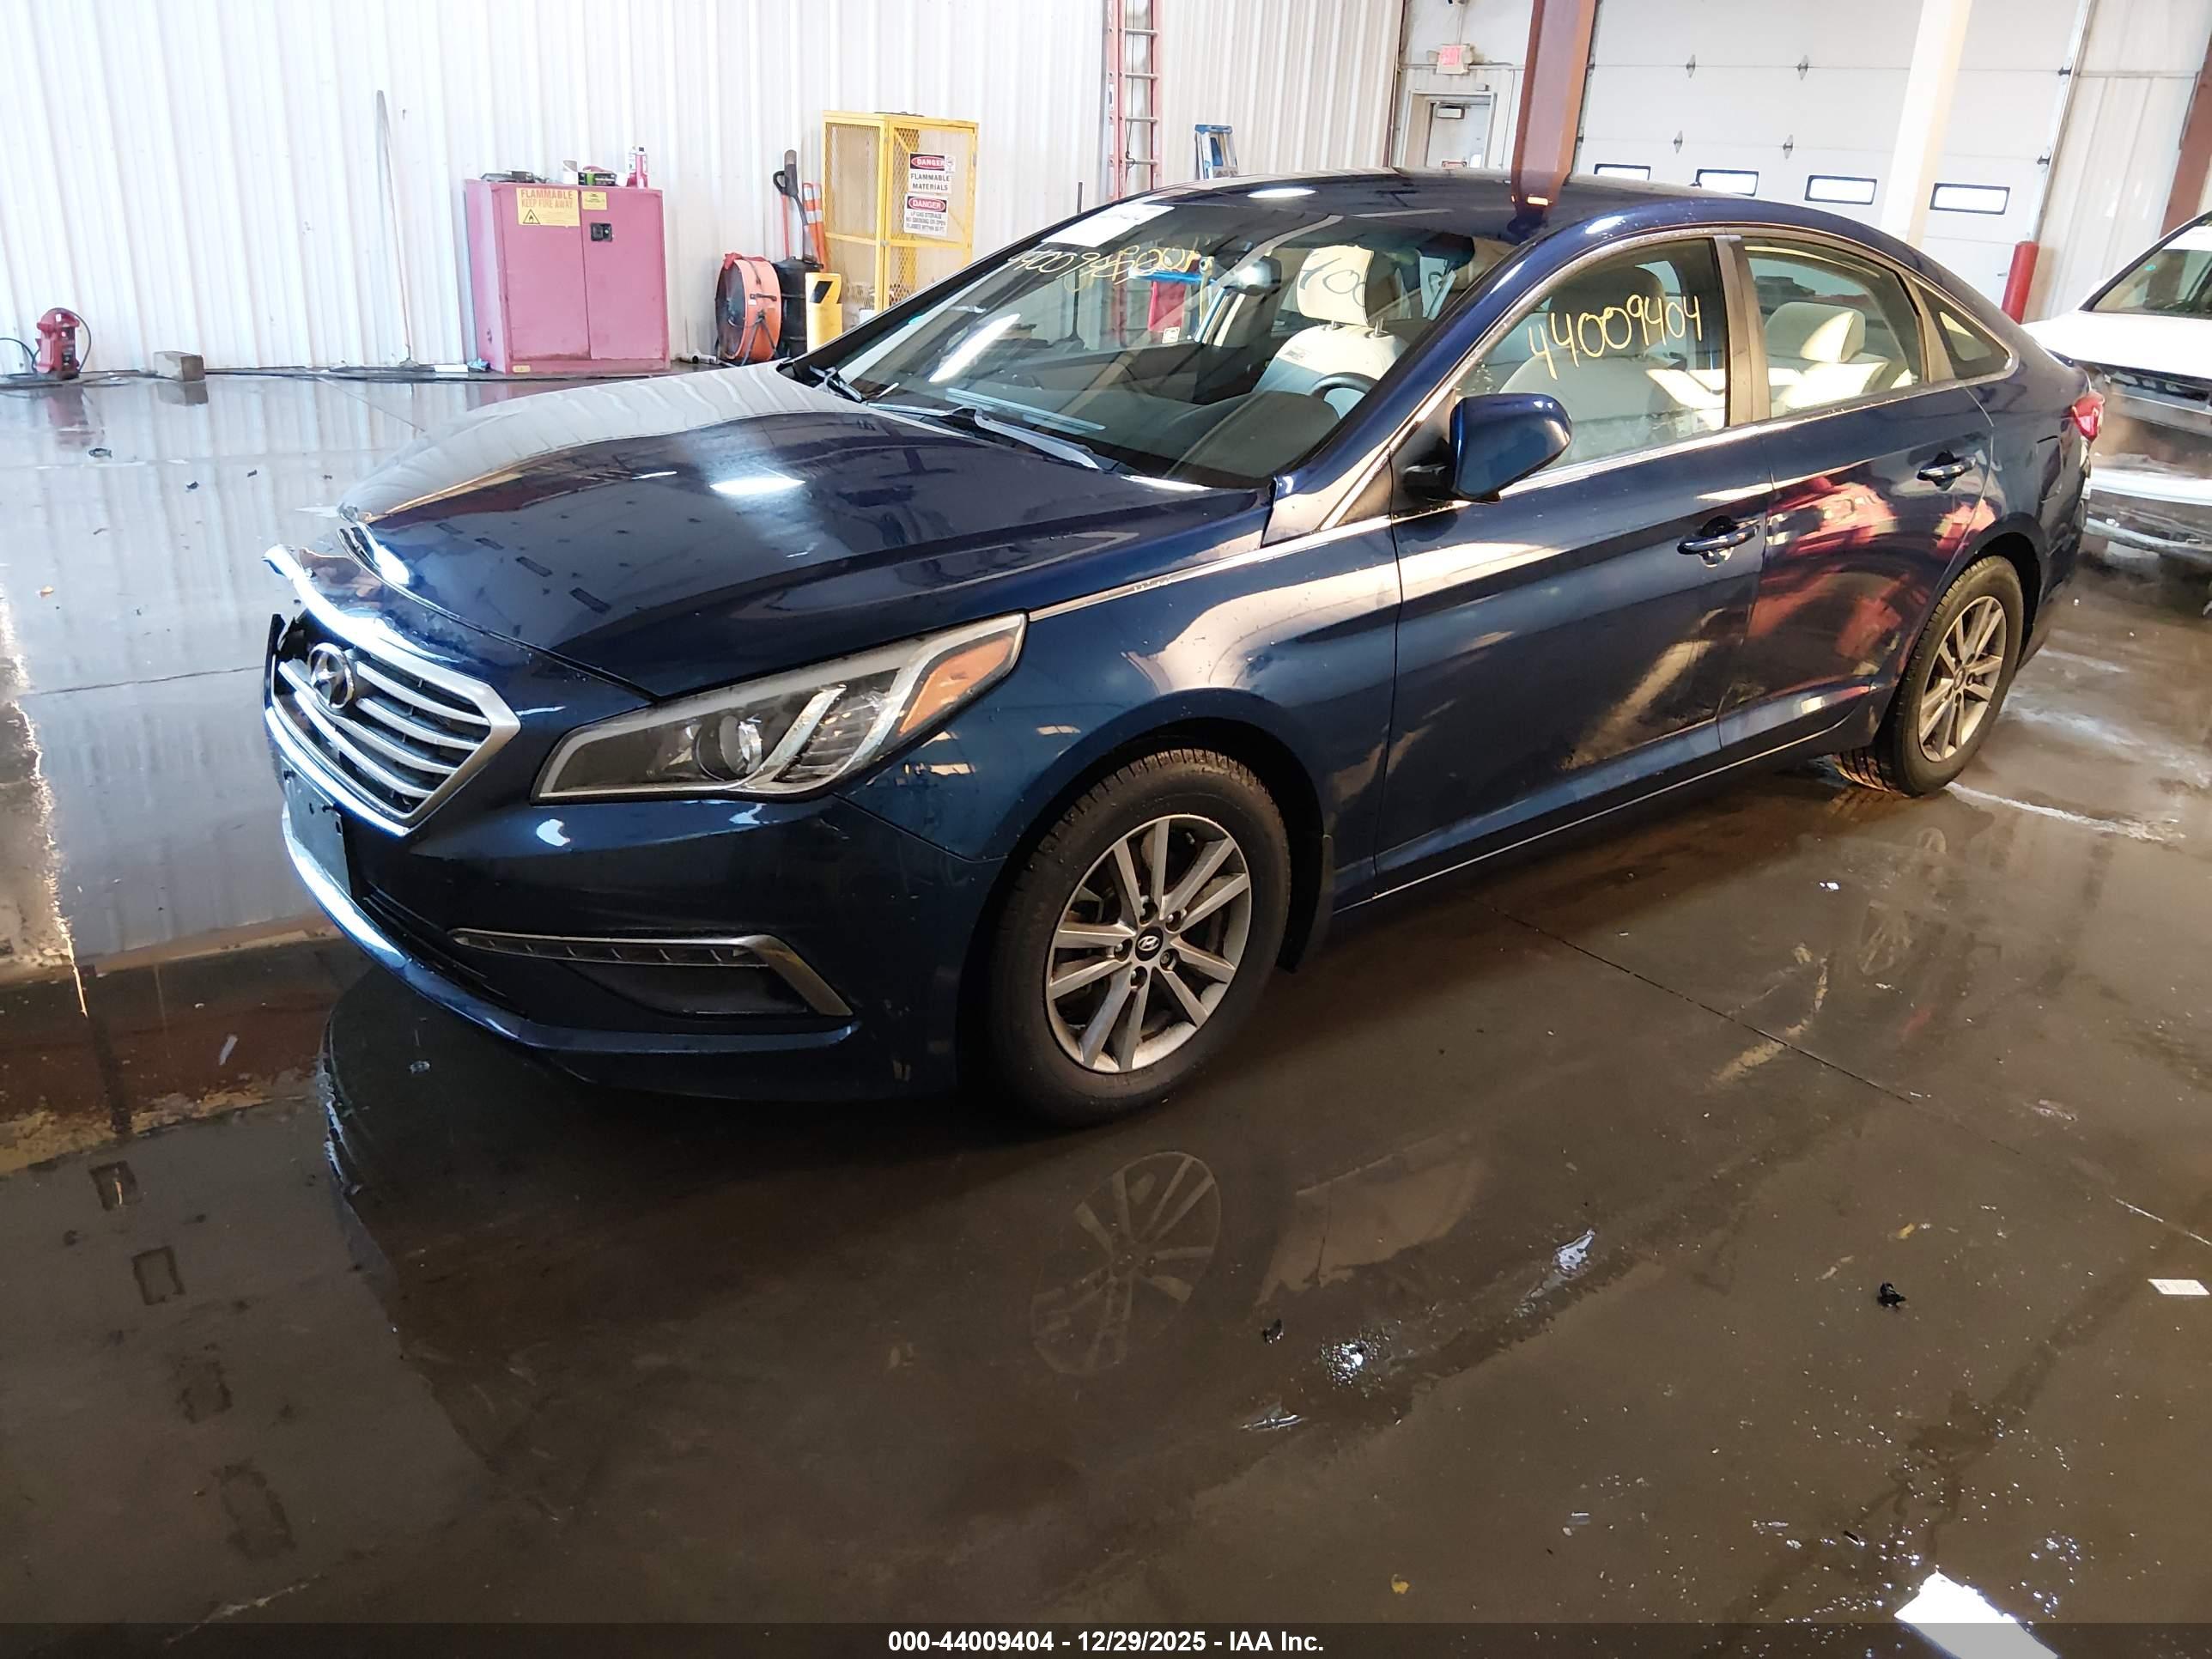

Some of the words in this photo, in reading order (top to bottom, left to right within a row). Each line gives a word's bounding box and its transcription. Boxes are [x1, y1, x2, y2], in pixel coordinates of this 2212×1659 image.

[916, 158, 945, 167] DANGER
[910, 173, 950, 182] FLAMMABLE
[520, 189, 574, 200] FLAMMABLE
[912, 199, 942, 210] DANGER
[1528, 294, 1703, 380] 44009404
